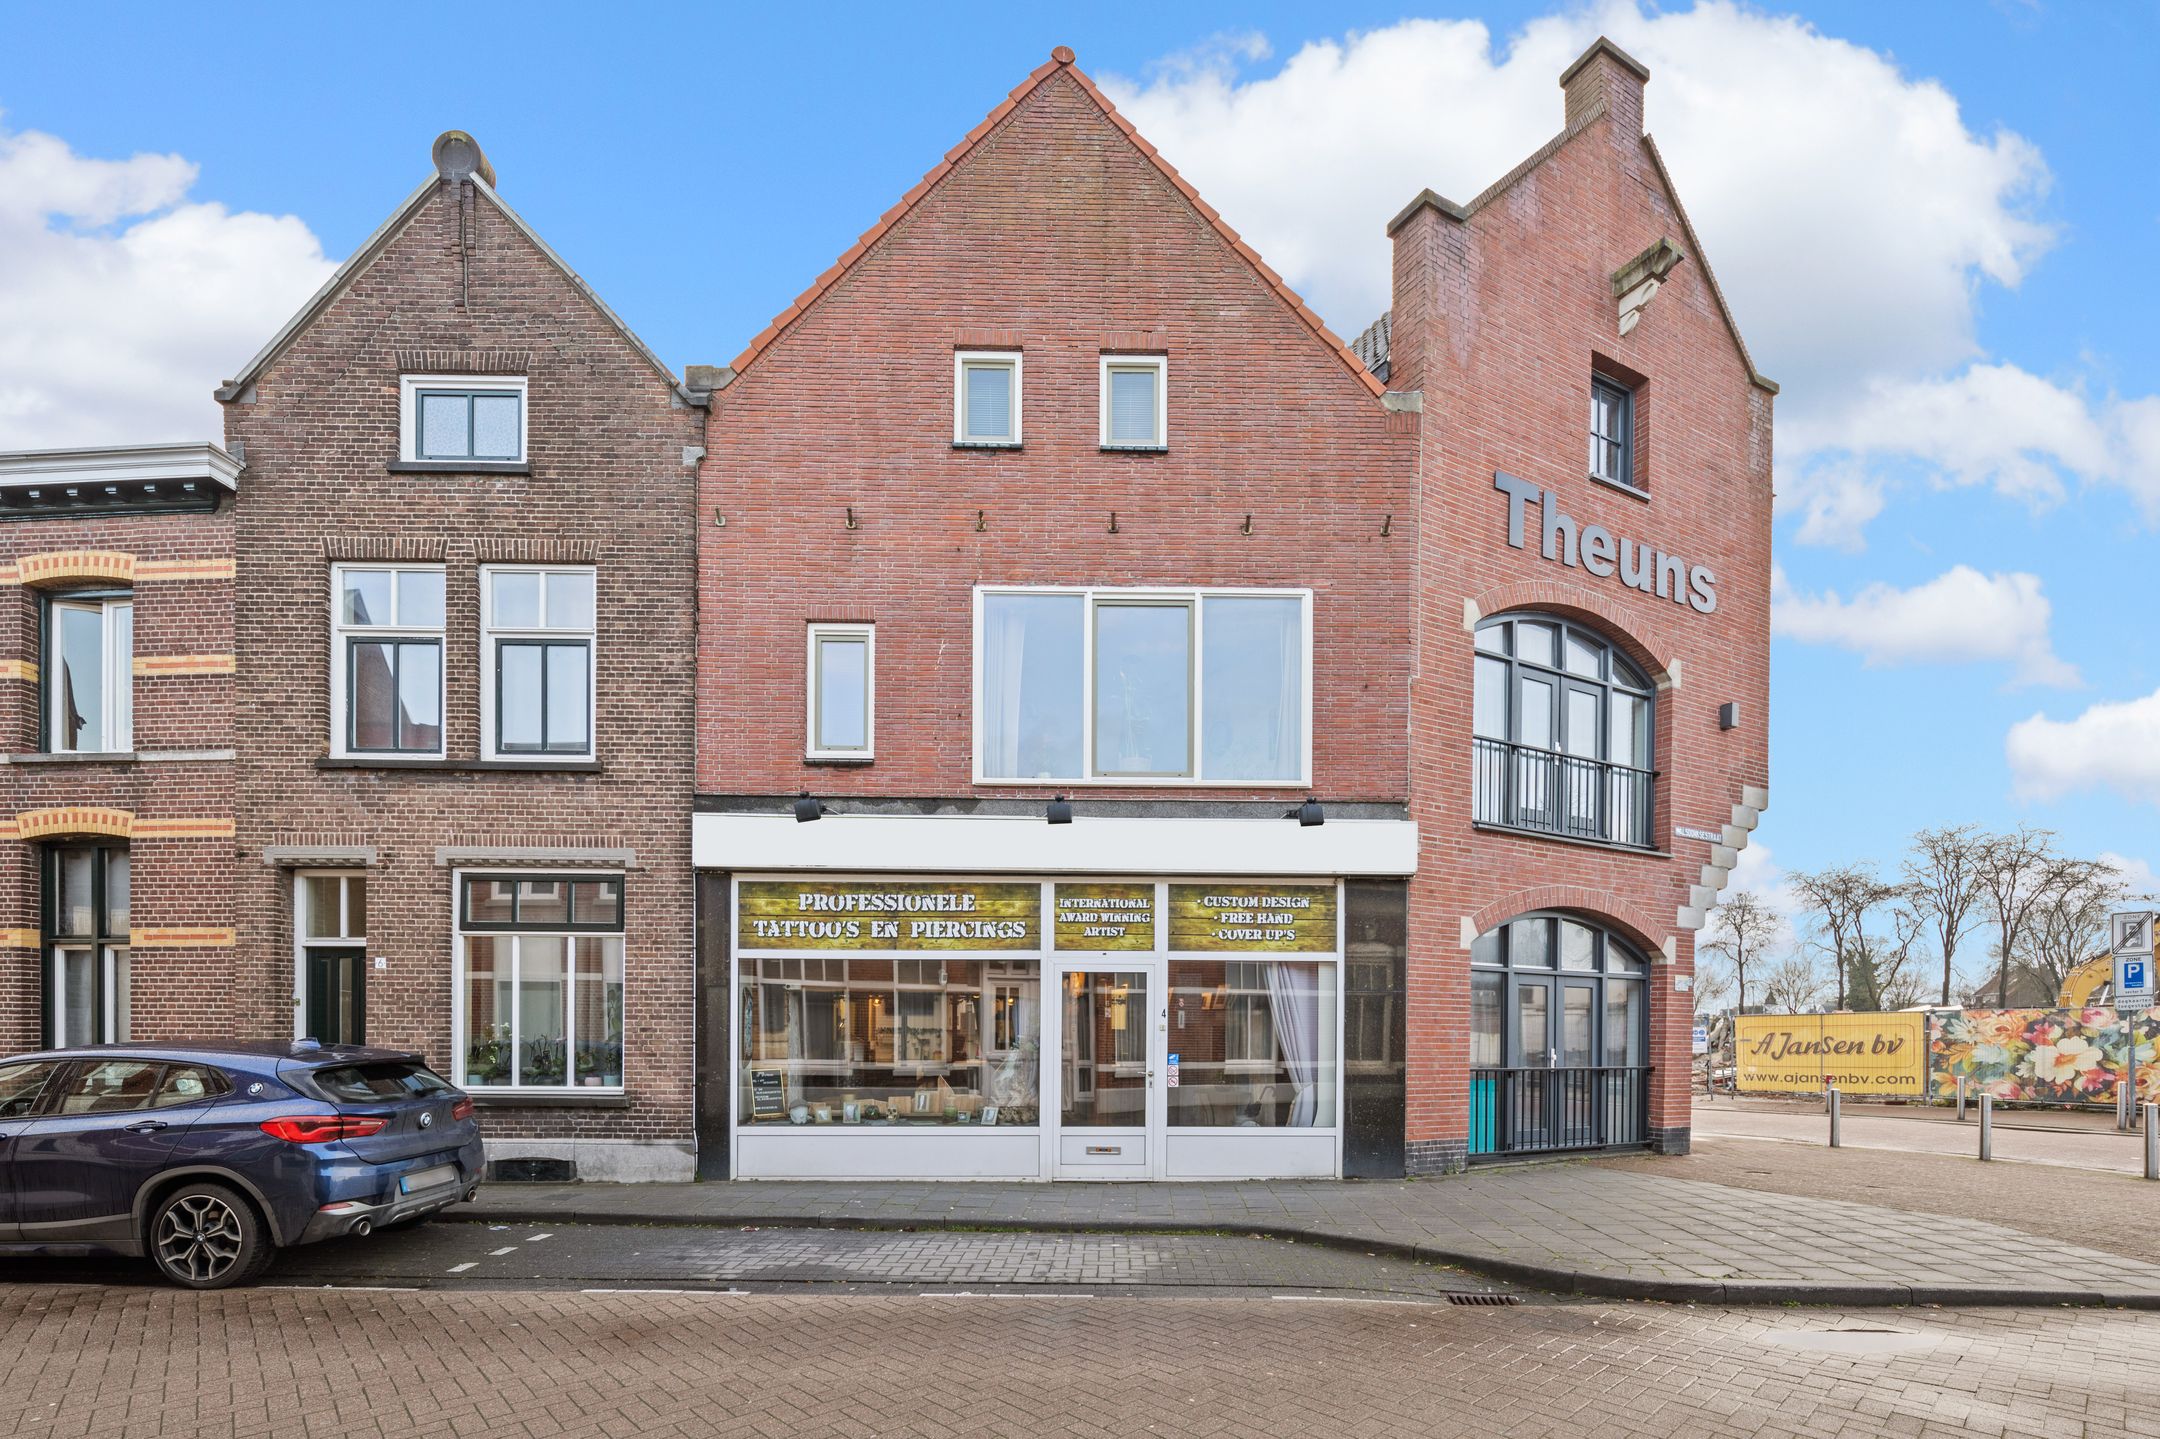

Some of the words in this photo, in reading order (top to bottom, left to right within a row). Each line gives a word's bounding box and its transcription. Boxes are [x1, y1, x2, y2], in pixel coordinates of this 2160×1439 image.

[1494, 470, 1717, 614] Theuns
[799, 894, 976, 912] PROFESSIONELE
[1059, 898, 1150, 909] INTERNATIONAL
[1203, 896, 1259, 908] CUSTOM
[1262, 896, 1311, 908] DESIGN
[1058, 912, 1098, 923] AWARD
[1100, 912, 1151, 924] WINNING
[1220, 913, 1254, 925] FREE
[1256, 913, 1294, 925] HAND
[753, 920, 860, 938] TATTOO'S
[871, 921, 898, 938] EN
[910, 921, 1027, 939] PIERCINGS
[1083, 926, 1126, 937] ARTIST
[1218, 928, 1262, 940] COVER
[1264, 929, 1296, 941] UP'S
[2127, 964, 2140, 979] P
[1161, 1008, 1166, 1018] 4
[1871, 1034, 1904, 1054] bv
[1743, 1072, 1916, 1086] www.ajansenbv.com
